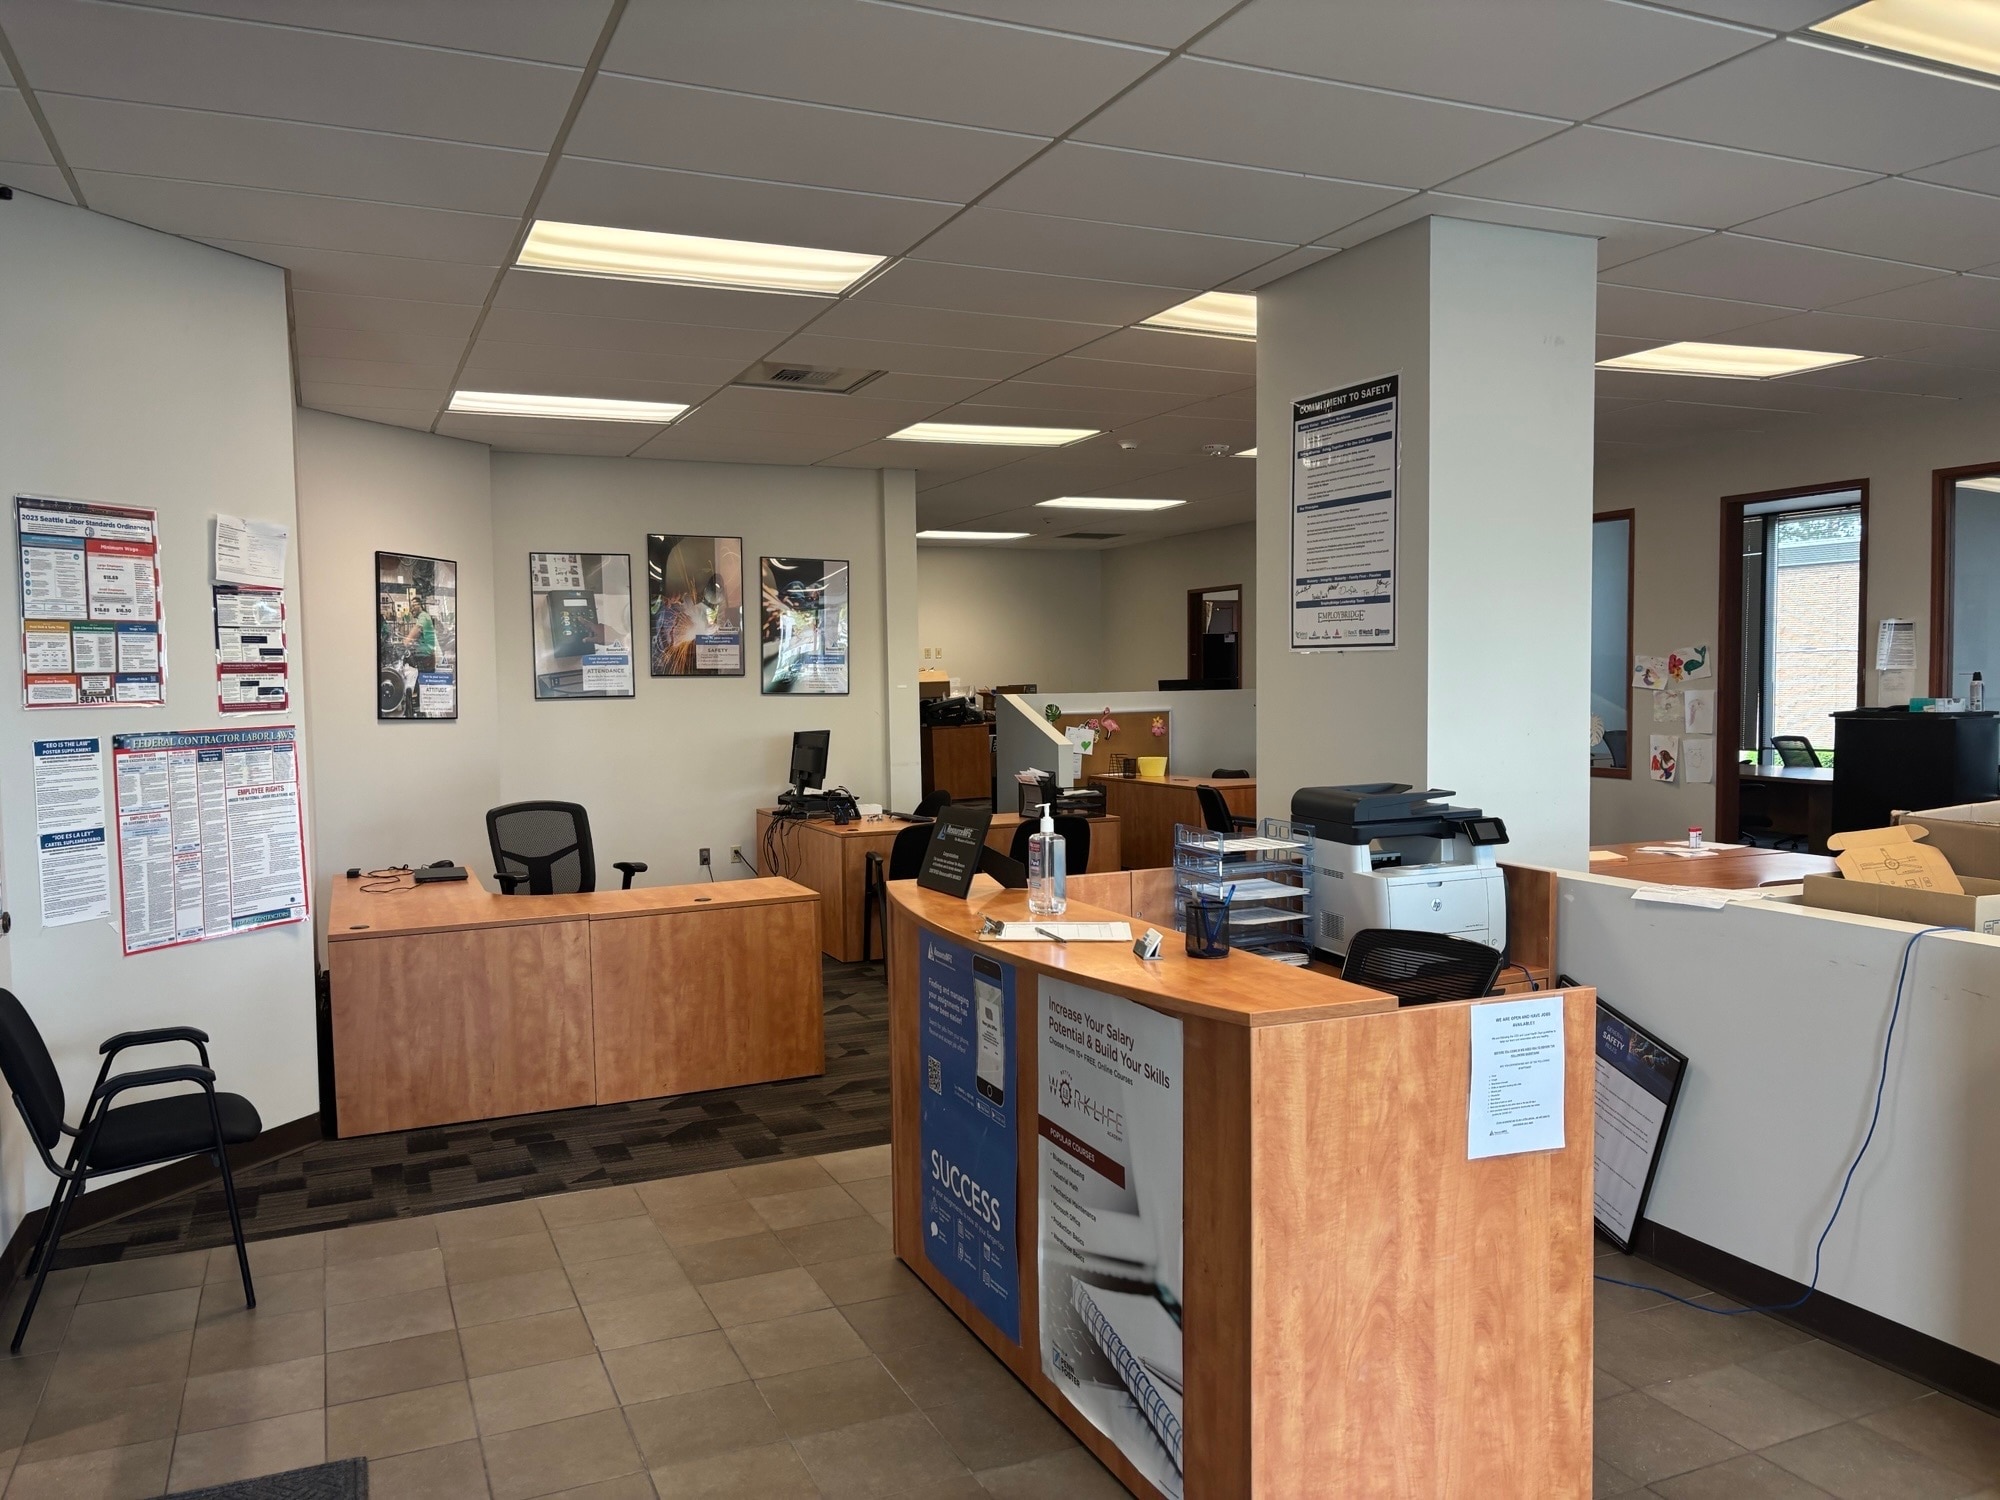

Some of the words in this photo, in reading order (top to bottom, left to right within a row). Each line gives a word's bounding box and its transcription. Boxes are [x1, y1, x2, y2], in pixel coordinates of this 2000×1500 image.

[1300, 395, 1346, 414] COMMITMENT
[1349, 392, 1359, 401] TO
[1361, 383, 1391, 398] SAFETY
[86, 520, 115, 528] Standards
[1318, 610, 1365, 623] EMPLOYBRIDGE
[133, 737, 175, 749] FEDERAL
[178, 732, 240, 746] CONTRACTOR
[242, 732, 270, 742] LABOR
[271, 730, 294, 740] LAWS
[238, 786, 264, 796] EMPLOYEE
[947, 825, 973, 837] ResourceMFG
[1432, 899, 1441, 912] hp
[934, 947, 953, 964] ResourceMFG
[928, 977, 942, 993] Finding
[950, 988, 969, 1007] managing
[928, 991, 937, 1003] your
[938, 994, 960, 1013] assignments
[929, 1002, 939, 1014] never
[940, 1006, 949, 1018] been
[950, 1010, 962, 1026] easier!
[1048, 996, 1082, 1024] Increase
[1084, 1012, 1104, 1035] Your
[1106, 1023, 1134, 1052] Salary
[1602, 1030, 1624, 1051] SAFETY
[1606, 1025, 1624, 1041] GENERAL
[1048, 1016, 1084, 1045] Potential
[1086, 1035, 1092, 1050] &
[1095, 1037, 1118, 1062] Build
[1120, 1050, 1141, 1075] Your
[1144, 1063, 1170, 1089] Skills
[1049, 1036, 1064, 1050] Choose
[1065, 1044, 1075, 1057] from
[1084, 1053, 1096, 1068] FREE,
[1097, 1061, 1113, 1076] Online
[1114, 1069, 1133, 1086] Courses
[1050, 1128, 1072, 1148] POPULAR
[1072, 1142, 1095, 1163] COURSES
[1052, 1152, 1068, 1168] Blueprint
[1069, 1164, 1085, 1181] Reading
[931, 1149, 1001, 1232] SUCCESS
[1053, 1170, 1068, 1186] Industrial
[1069, 1181, 1079, 1193] Math
[944, 1193, 963, 1216] assignments
[1053, 1185, 1071, 1203] Mechanical
[1072, 1200, 1096, 1222] Maintenance
[1053, 1200, 1069, 1216] Microsoft
[1070, 1213, 1080, 1227] Office
[1053, 1216, 1072, 1236] Production
[1072, 1232, 1084, 1247] Basics
[1054, 1233, 1072, 1253] Warehouse
[1073, 1248, 1085, 1264] Basics
[1061, 1357, 1074, 1374] PENN
[1062, 1366, 1080, 1388] FOSTER
